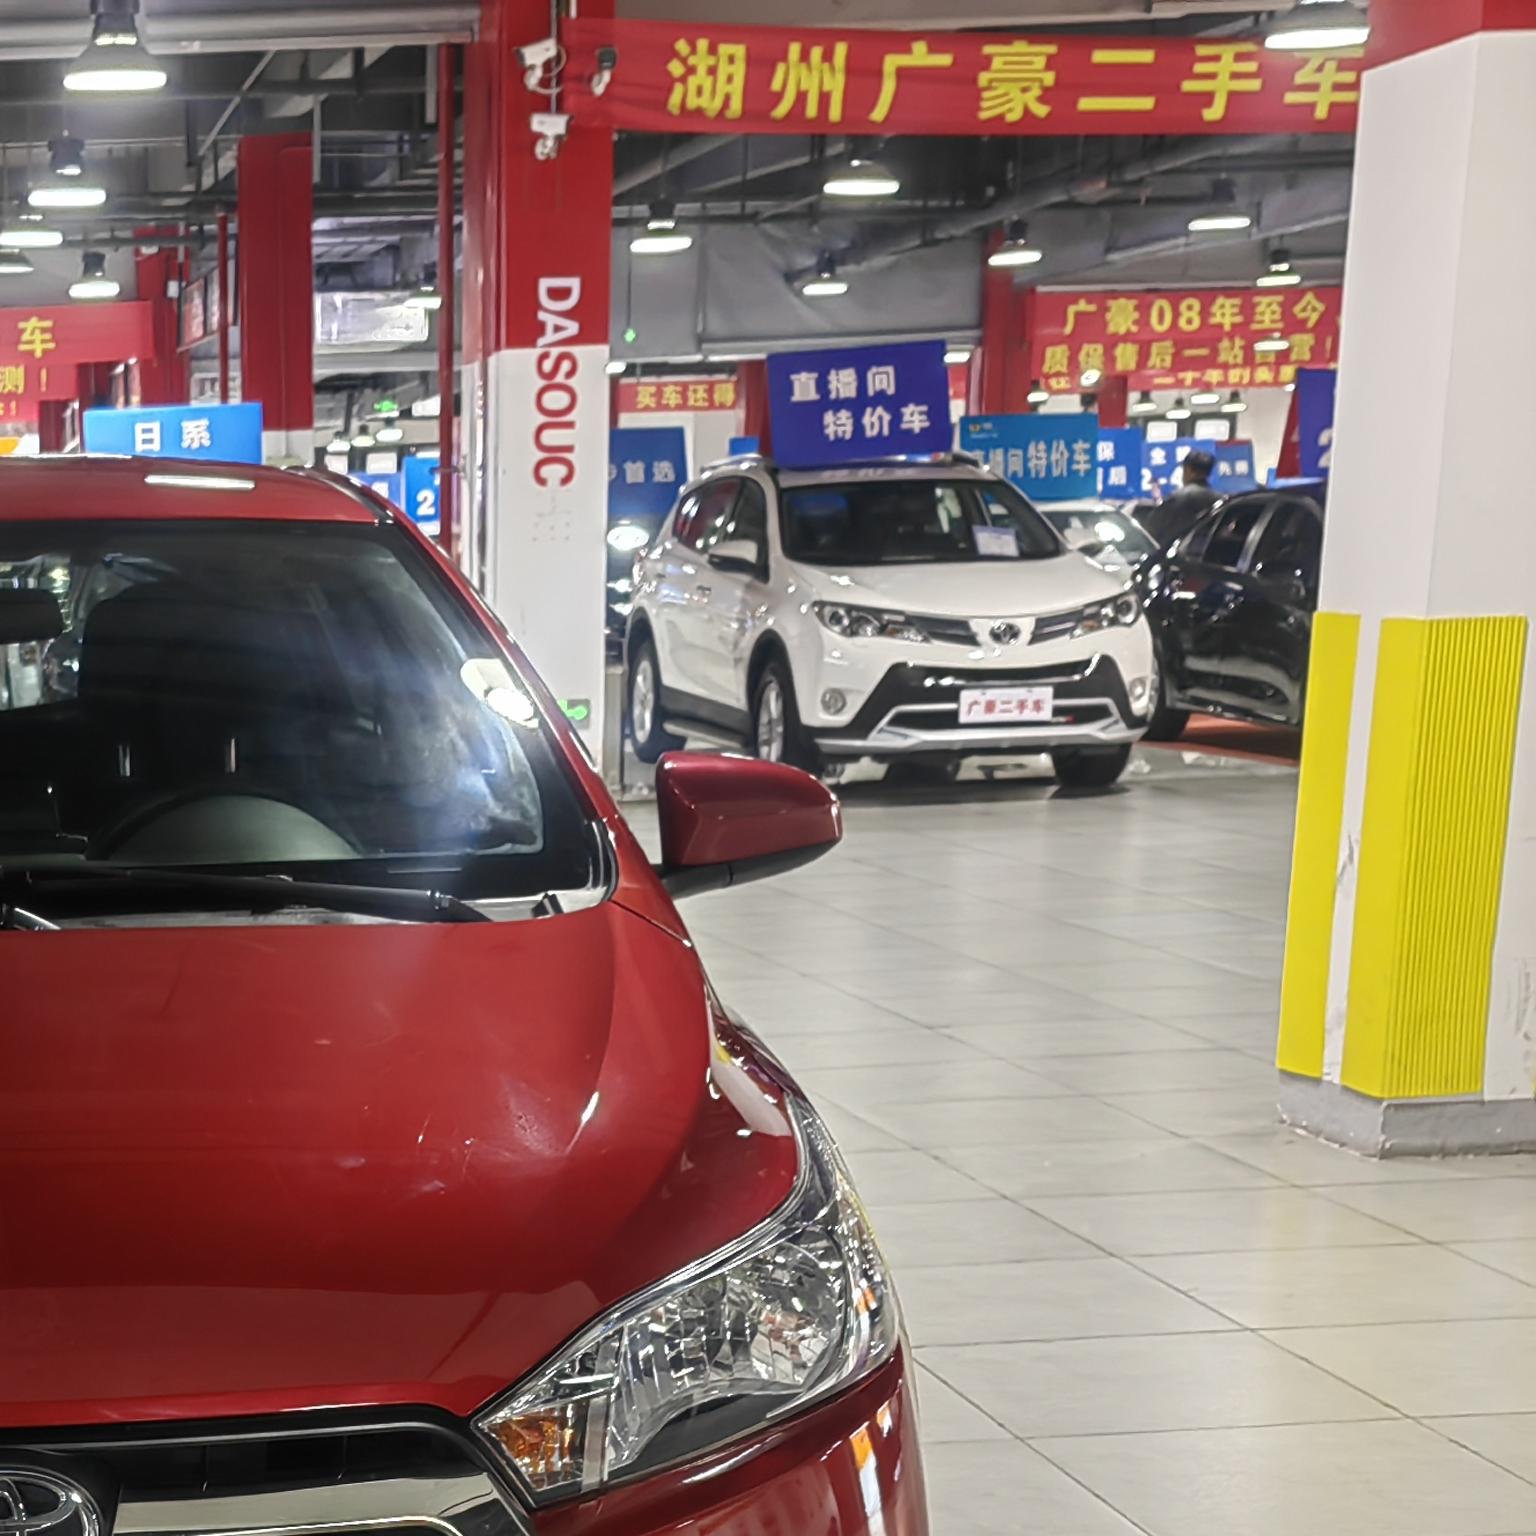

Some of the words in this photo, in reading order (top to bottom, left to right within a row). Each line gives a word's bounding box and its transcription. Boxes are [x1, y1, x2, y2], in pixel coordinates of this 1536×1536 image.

[666, 37, 1364, 125] 湖州广豪二手车
[532, 276, 581, 488] DASOUC
[790, 365, 896, 402] 直播间
[134, 419, 212, 451] 日系
[823, 404, 931, 441] 特价车
